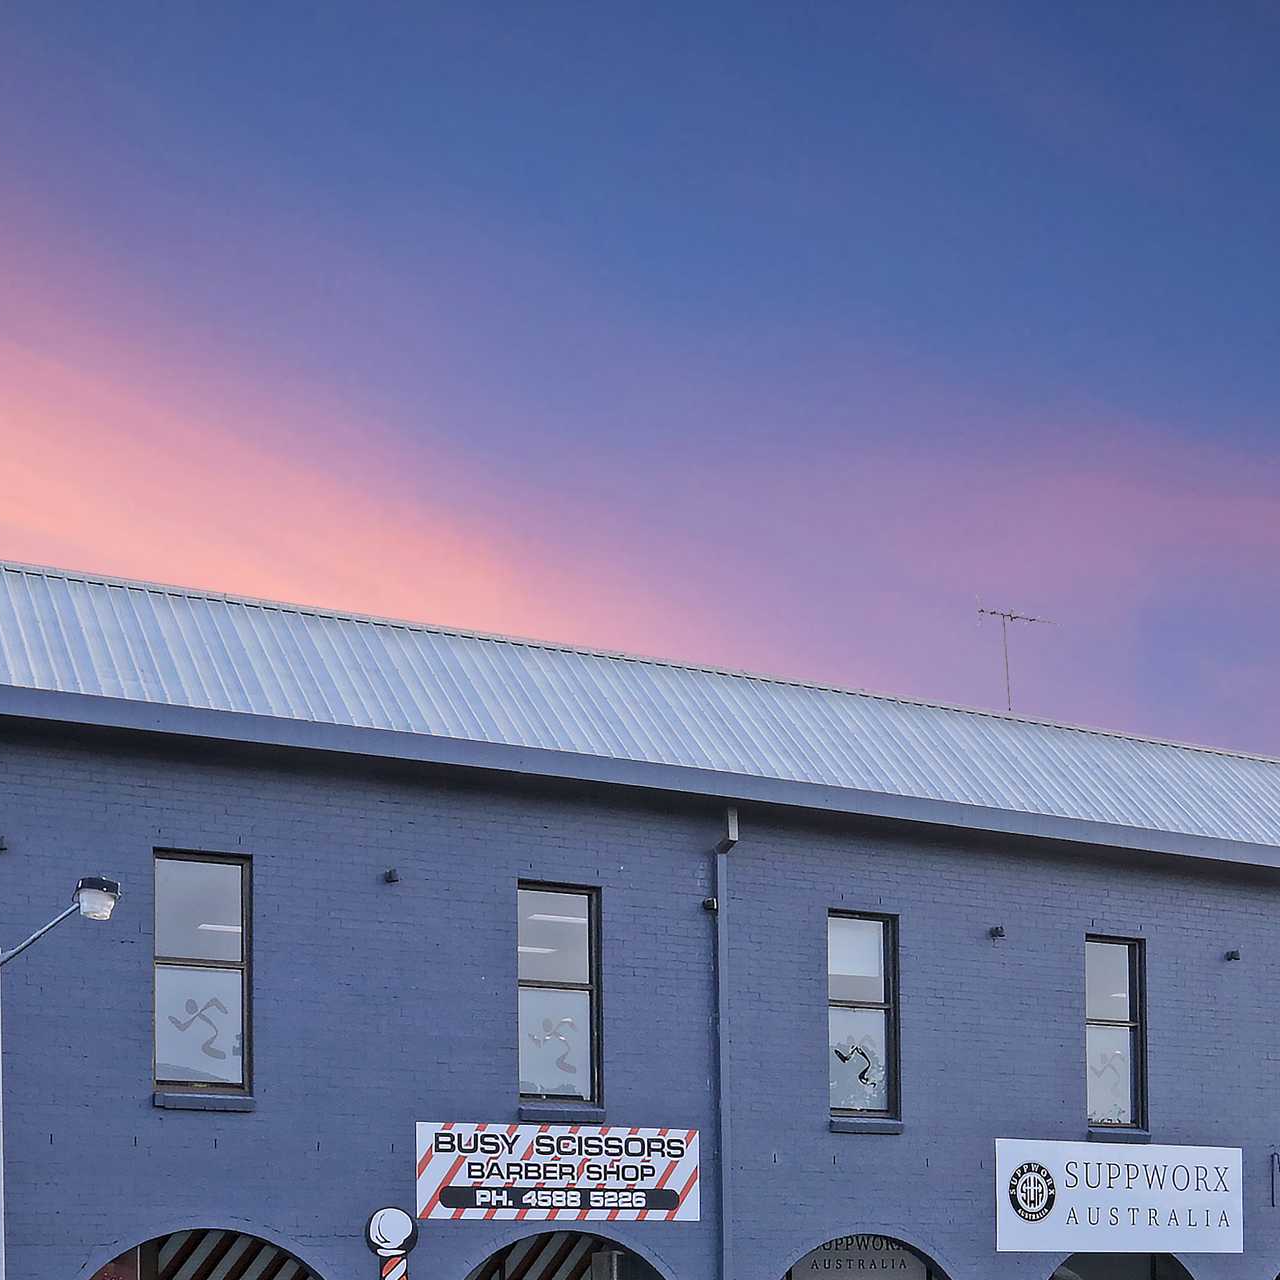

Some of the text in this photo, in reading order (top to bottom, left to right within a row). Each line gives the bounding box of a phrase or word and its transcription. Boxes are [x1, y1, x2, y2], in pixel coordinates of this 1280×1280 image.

[434, 1132, 686, 1159] BUSY SCISSORS
[467, 1161, 656, 1182] BARBER SHOP
[1008, 1162, 1056, 1196] SUPPWORX
[1065, 1161, 1231, 1193] SUPPWORX
[475, 1189, 647, 1208] PH. 4588 5226
[1066, 1206, 1231, 1228] AUSTRALIA
[821, 1235, 904, 1250] UPPWOR
[810, 1258, 908, 1270] AUSTRALIA
